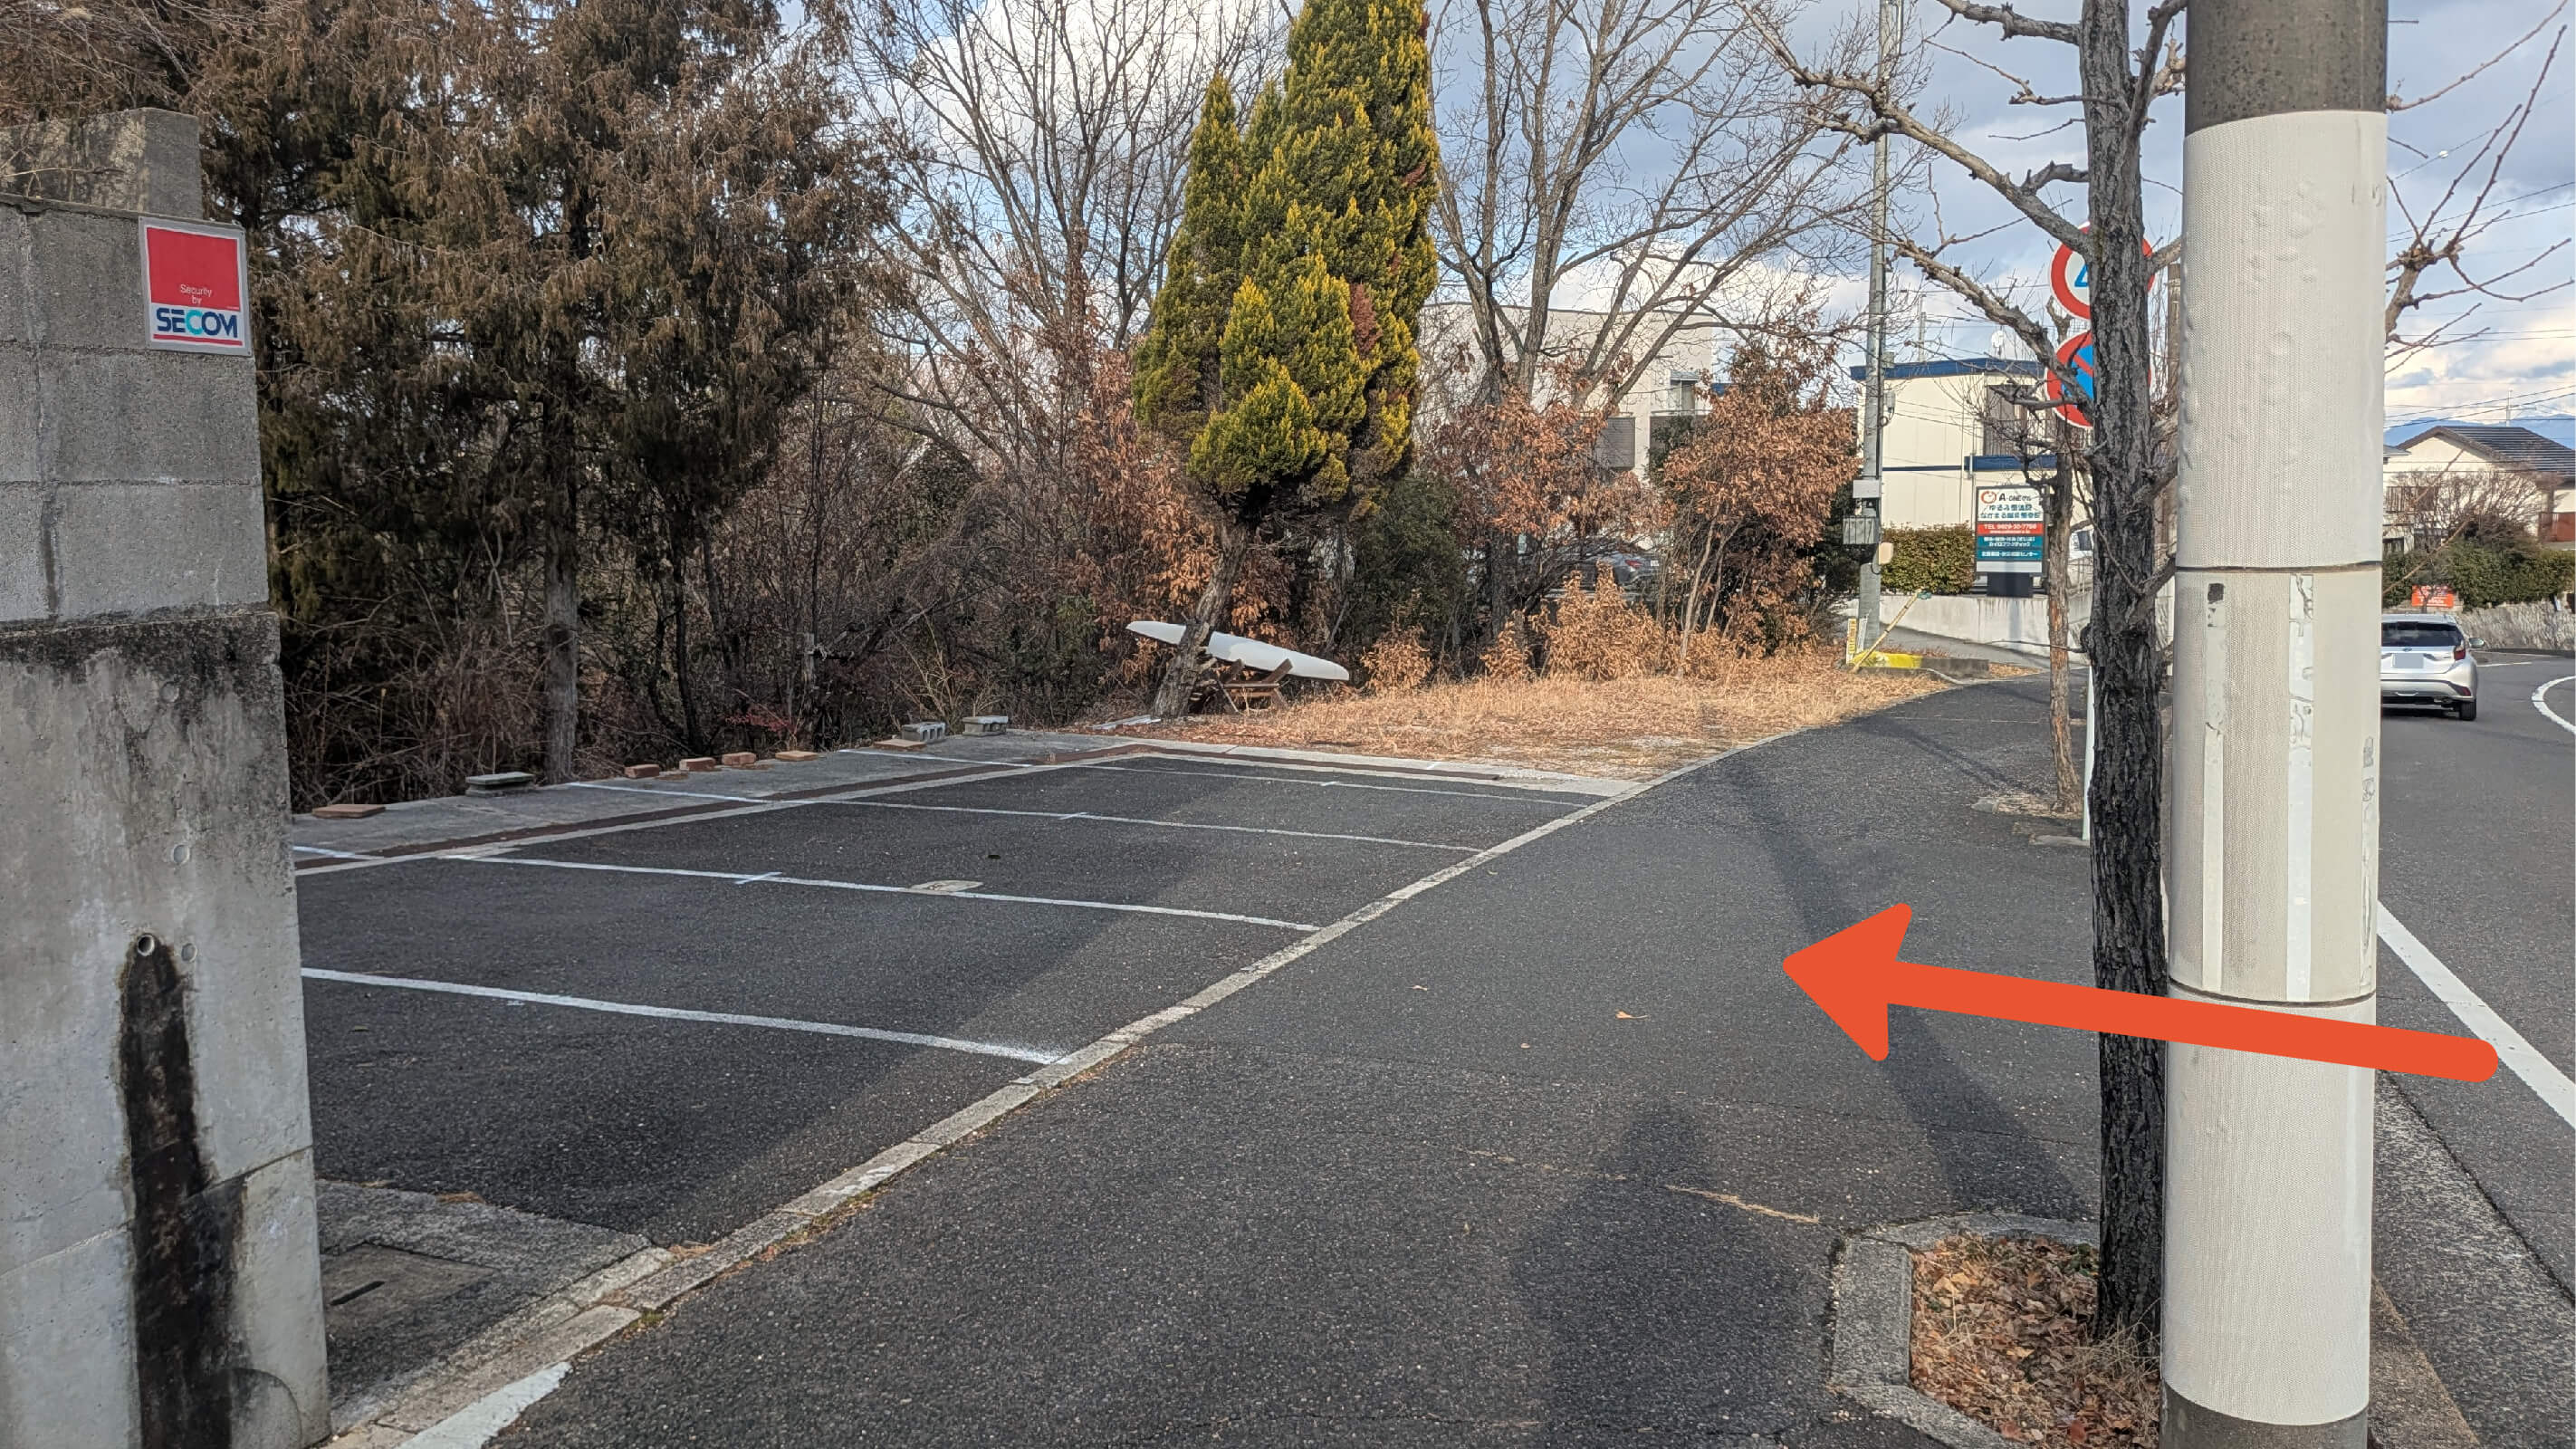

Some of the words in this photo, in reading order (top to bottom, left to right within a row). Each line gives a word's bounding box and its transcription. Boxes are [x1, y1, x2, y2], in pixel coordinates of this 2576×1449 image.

[180, 283, 213, 297] Security
[191, 294, 203, 305] by
[156, 308, 238, 339] SECOM
